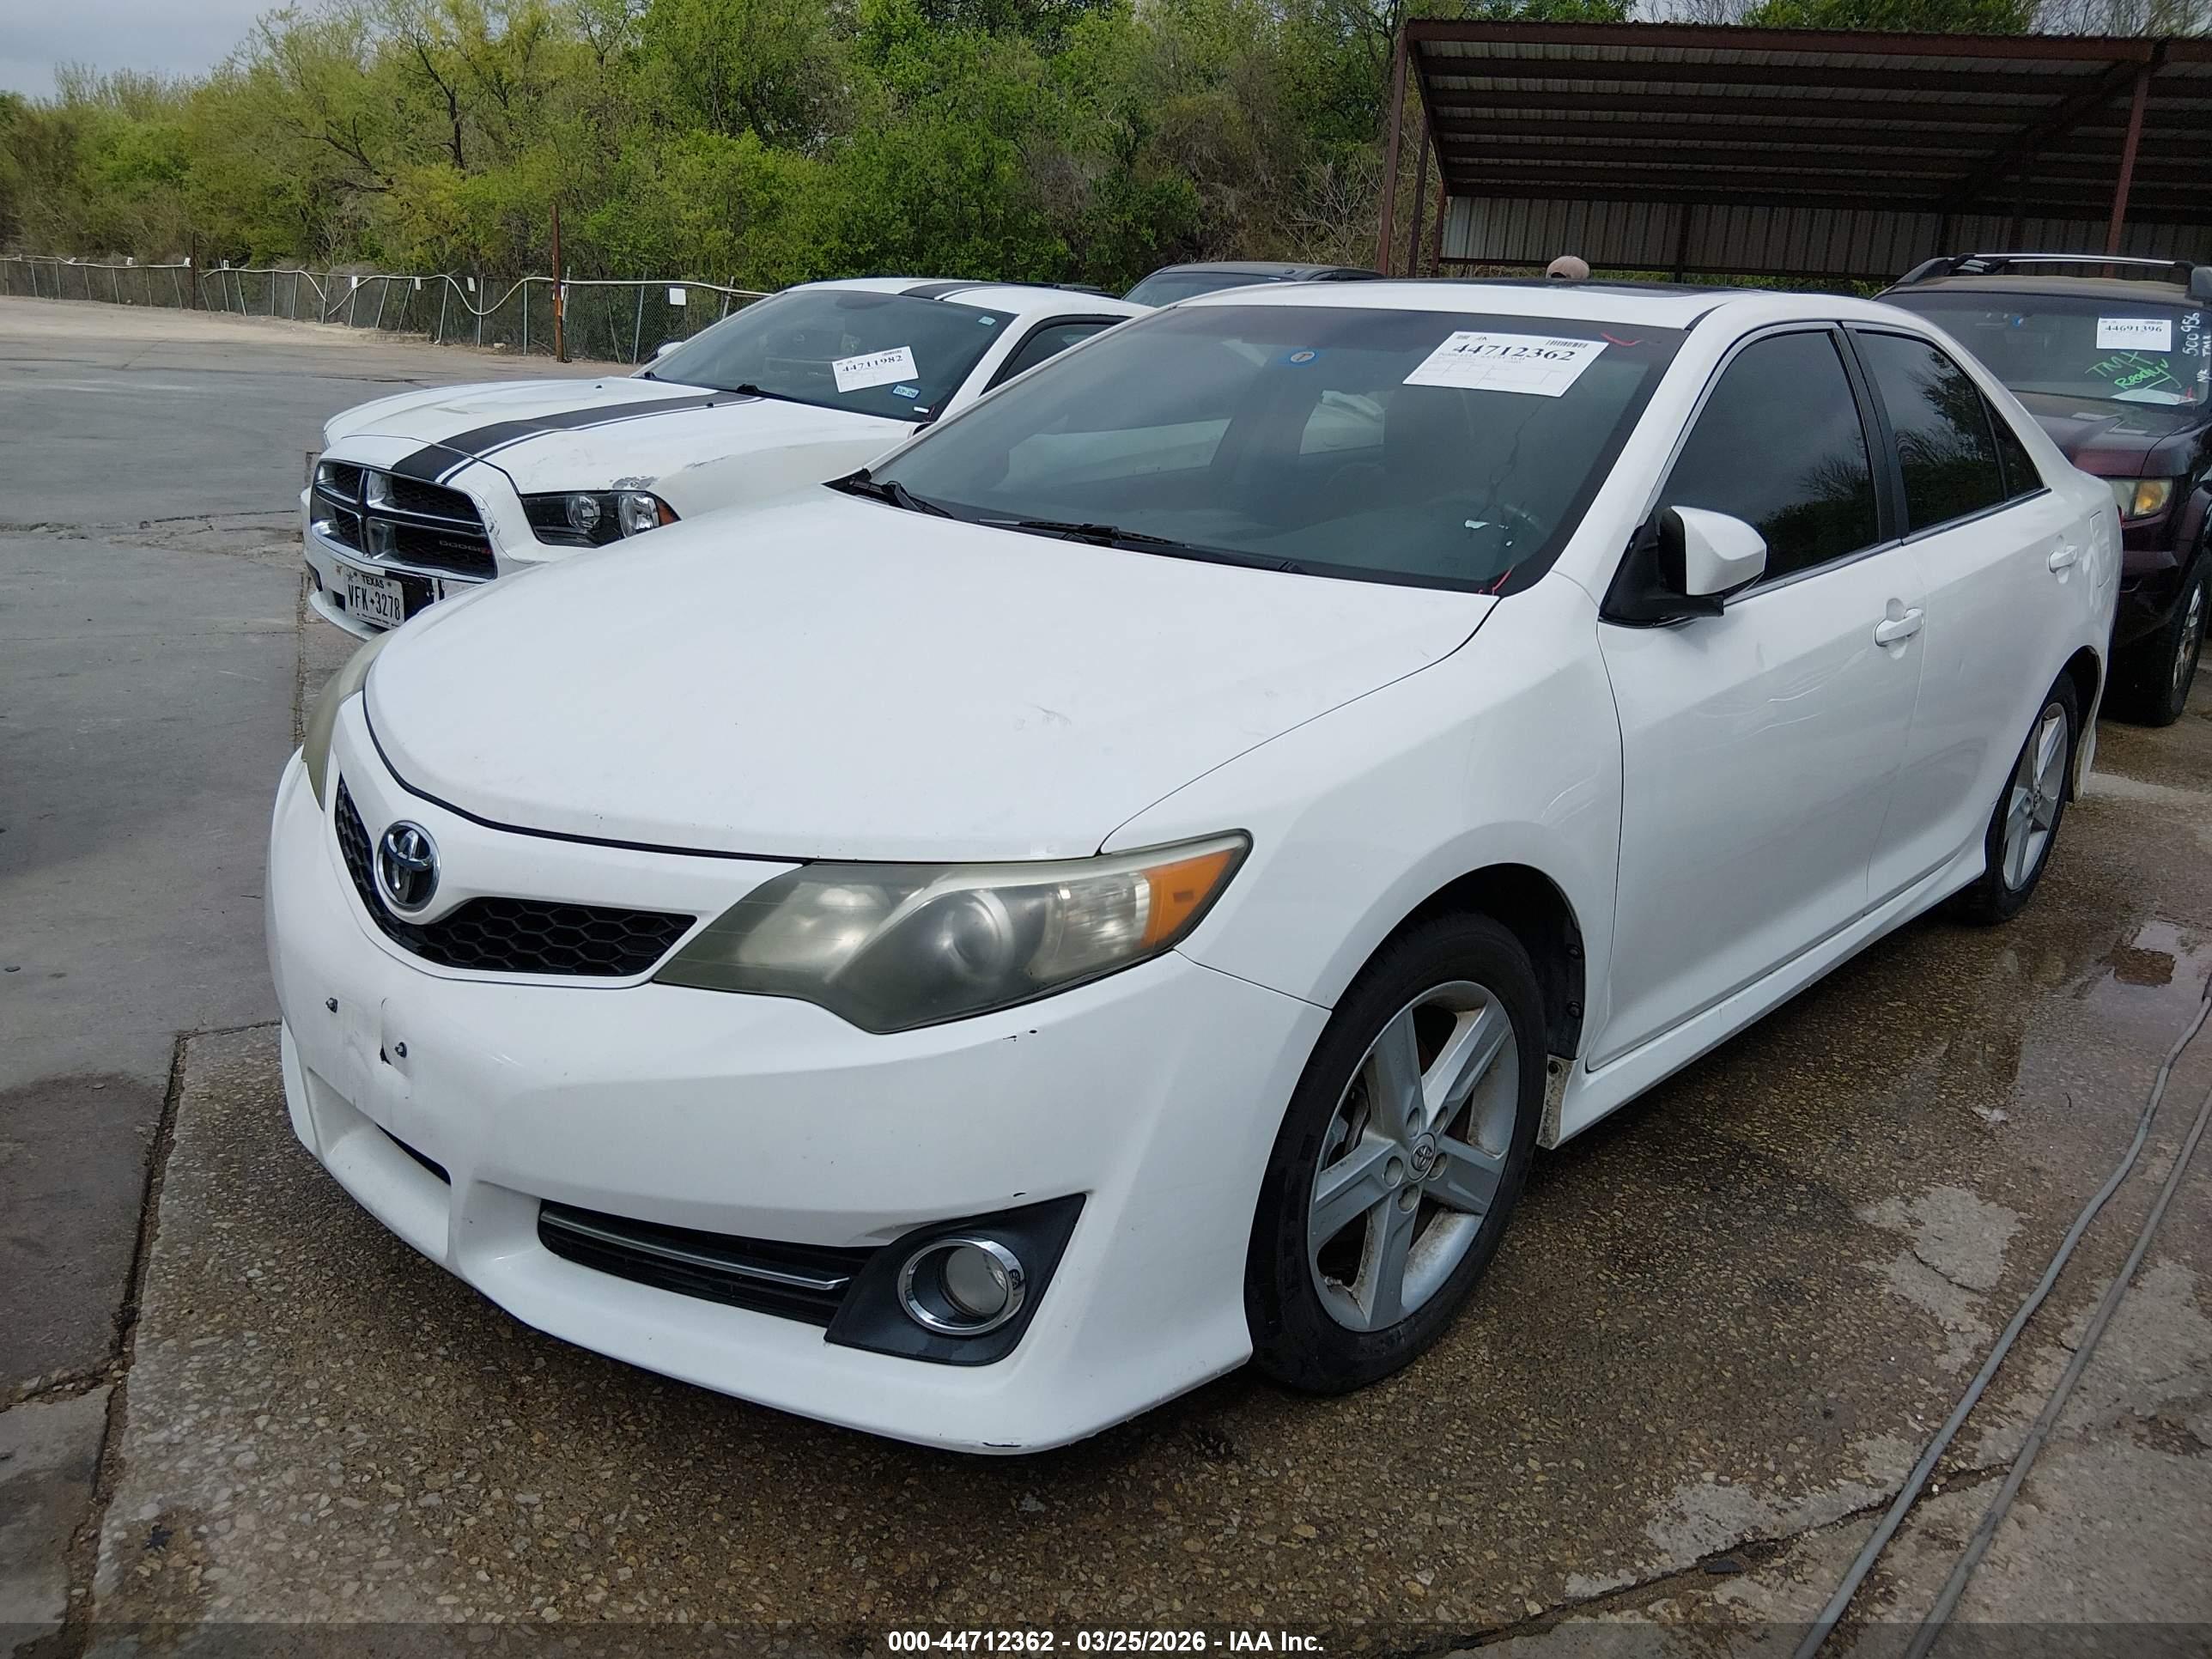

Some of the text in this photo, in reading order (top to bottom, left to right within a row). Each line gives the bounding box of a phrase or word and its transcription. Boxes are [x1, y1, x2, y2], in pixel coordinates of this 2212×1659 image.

[1453, 343, 1577, 362] 44712362
[2202, 335, 2211, 357] TMX
[842, 355, 903, 372] 44711982
[2084, 350, 2154, 377] TMX
[2114, 366, 2182, 390] Ready
[362, 574, 385, 589] TEXAS
